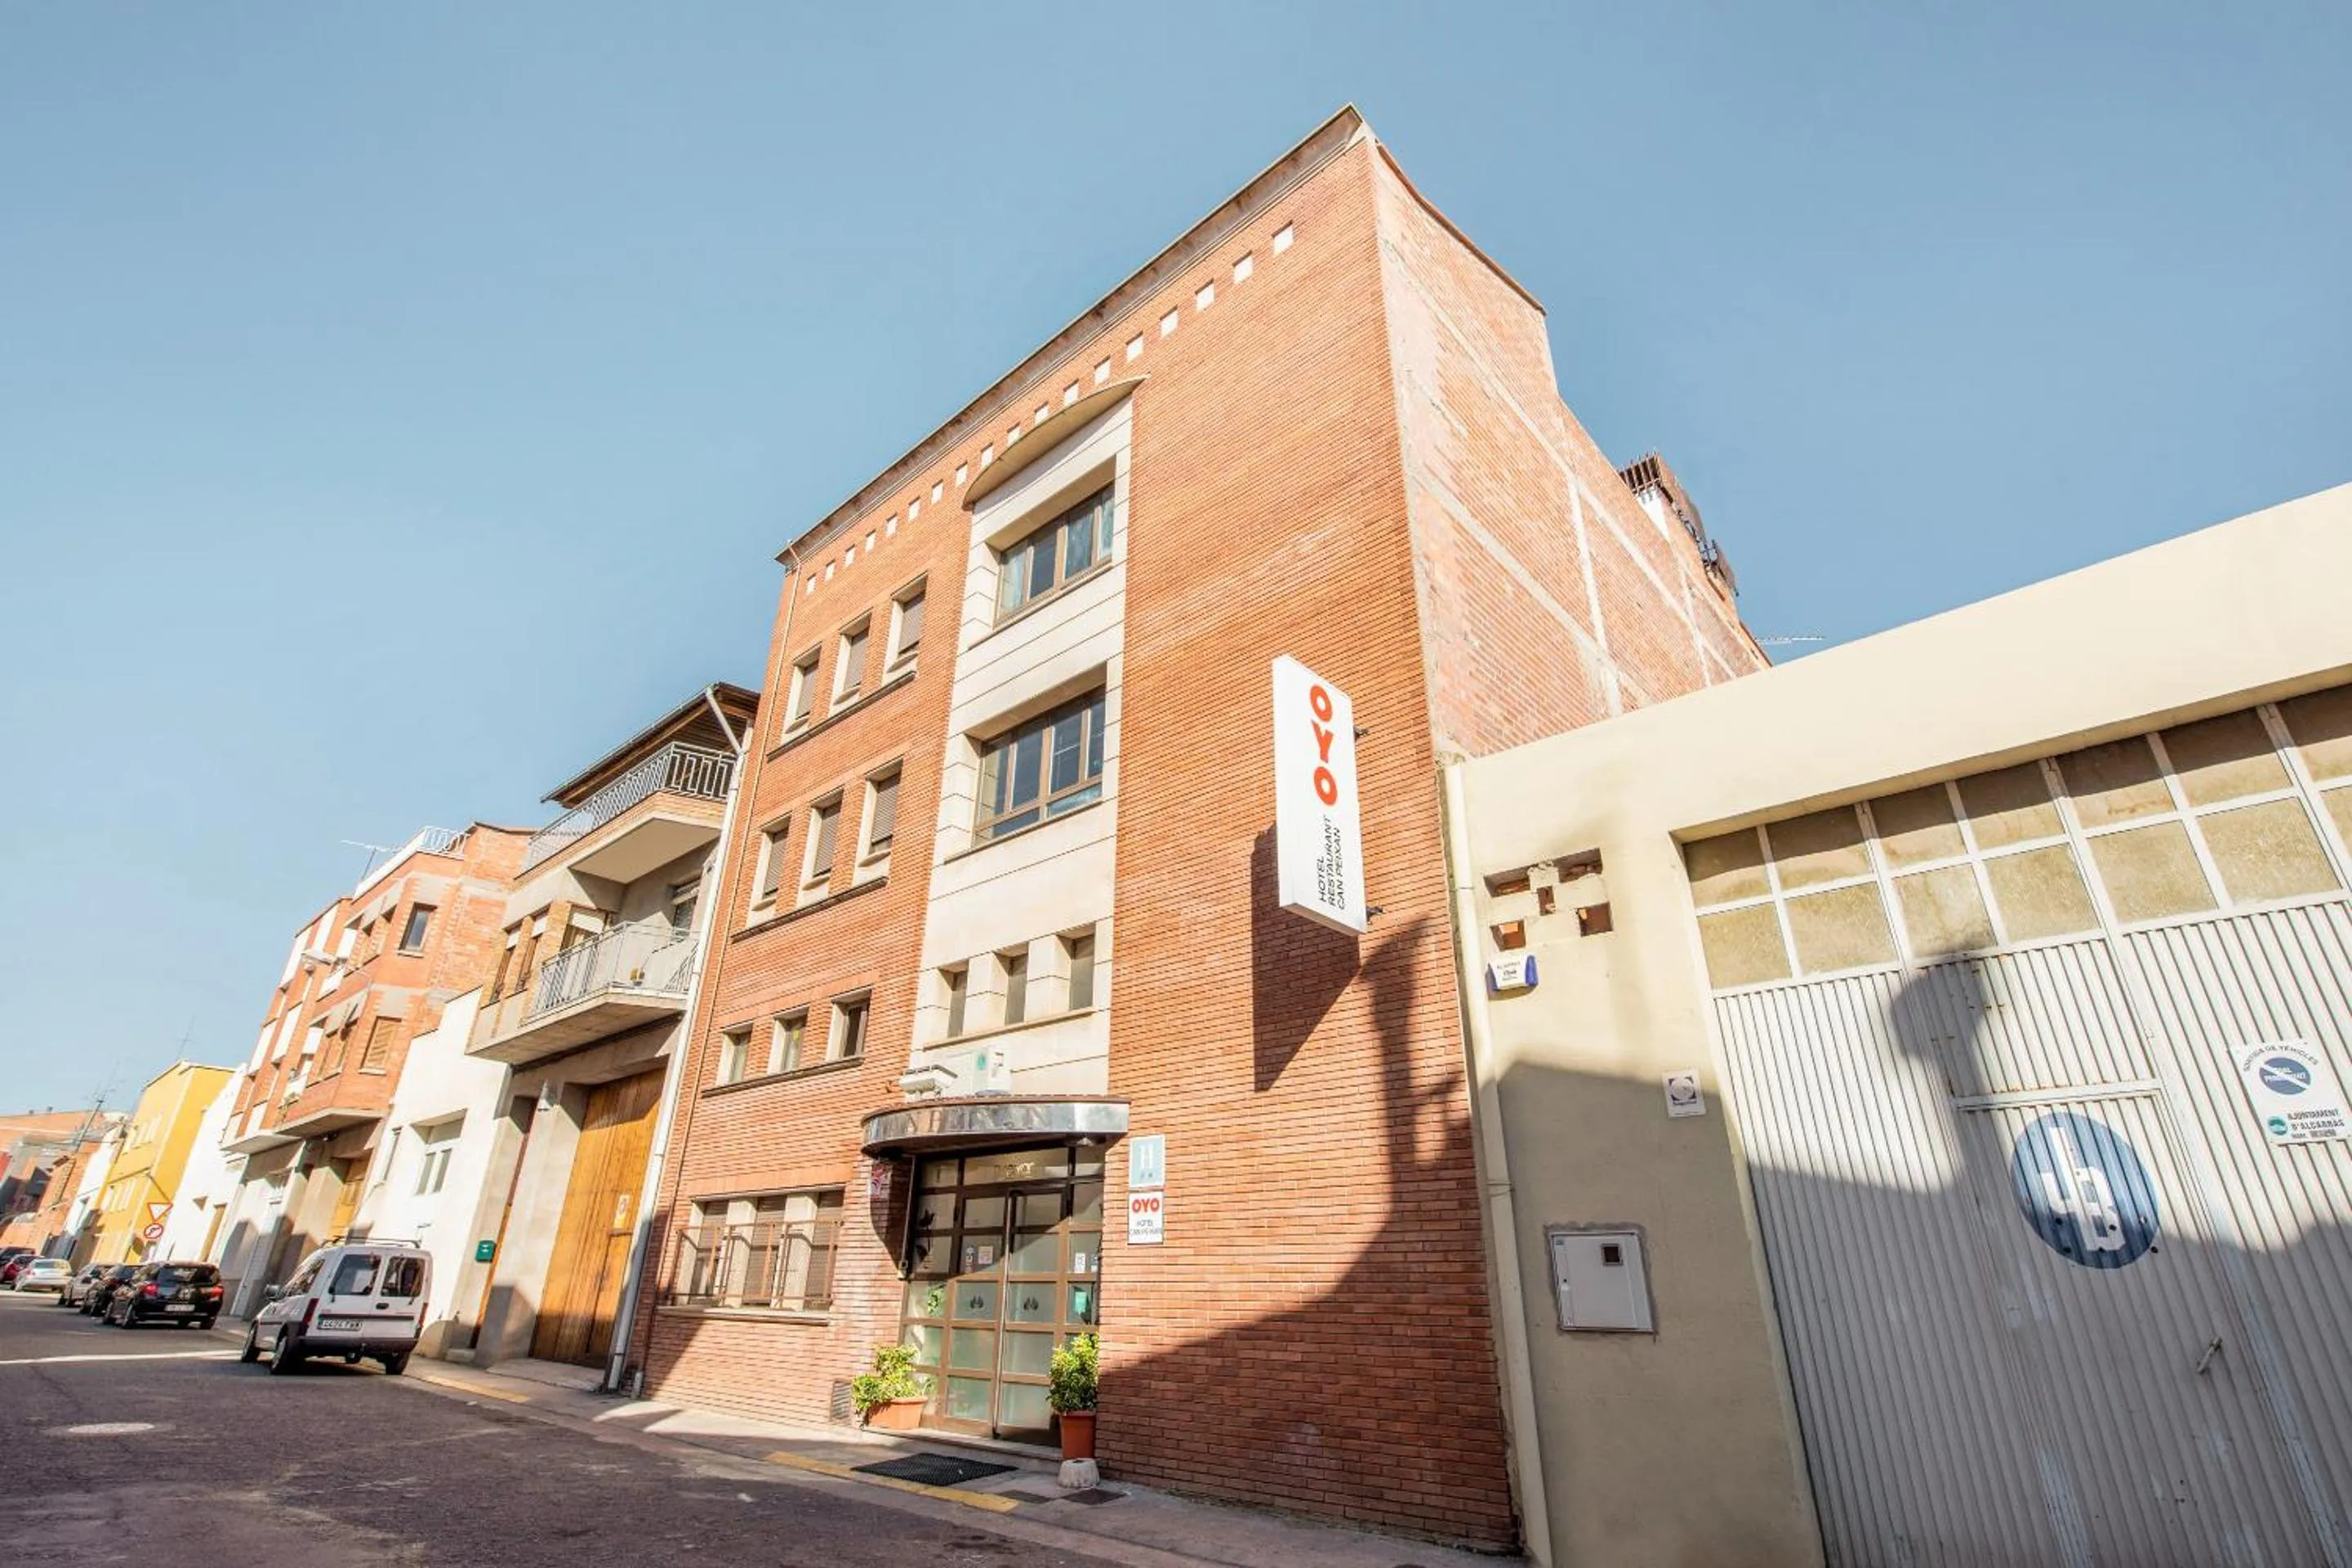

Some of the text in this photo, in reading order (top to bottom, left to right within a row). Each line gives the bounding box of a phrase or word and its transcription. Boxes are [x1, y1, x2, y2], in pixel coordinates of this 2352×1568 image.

[1309, 684, 1339, 806] OYO
[1316, 856, 1326, 902] HOTEL
[1323, 814, 1336, 907] RESTAURANT
[1336, 880, 1345, 910] CAN
[1132, 1198, 1160, 1213] OYO
